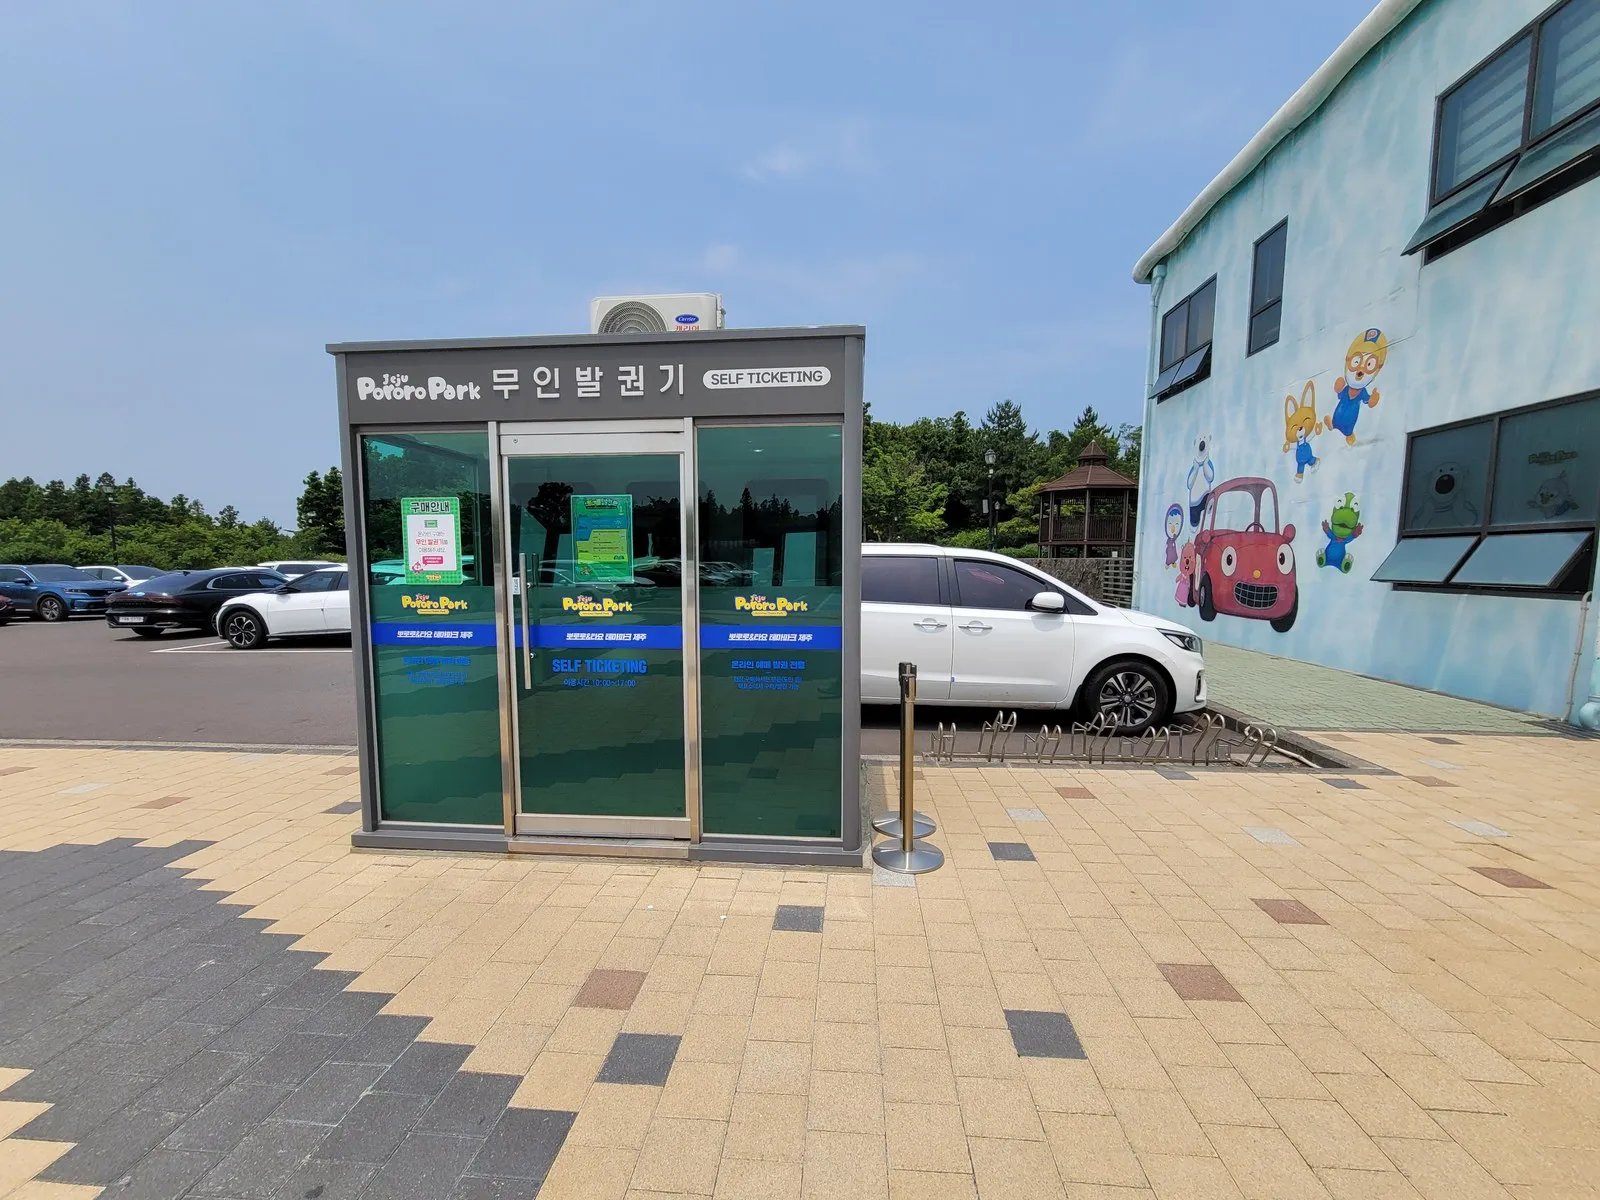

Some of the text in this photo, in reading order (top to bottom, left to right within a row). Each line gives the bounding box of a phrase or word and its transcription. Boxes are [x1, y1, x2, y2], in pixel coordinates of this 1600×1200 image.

[678, 315, 697, 323] Carrier
[382, 373, 409, 387] Jeju
[710, 370, 823, 386] SELF TICKETING
[356, 376, 481, 400] Pororo Park
[410, 501, 450, 513] 구매안내
[401, 595, 468, 610] Pororo Park
[562, 597, 633, 611] Pororo Park
[734, 596, 808, 611] Pororo Park
[632, 633, 647, 641] 제주
[798, 634, 813, 642] 제주
[552, 658, 648, 674] SELF TICKETING
